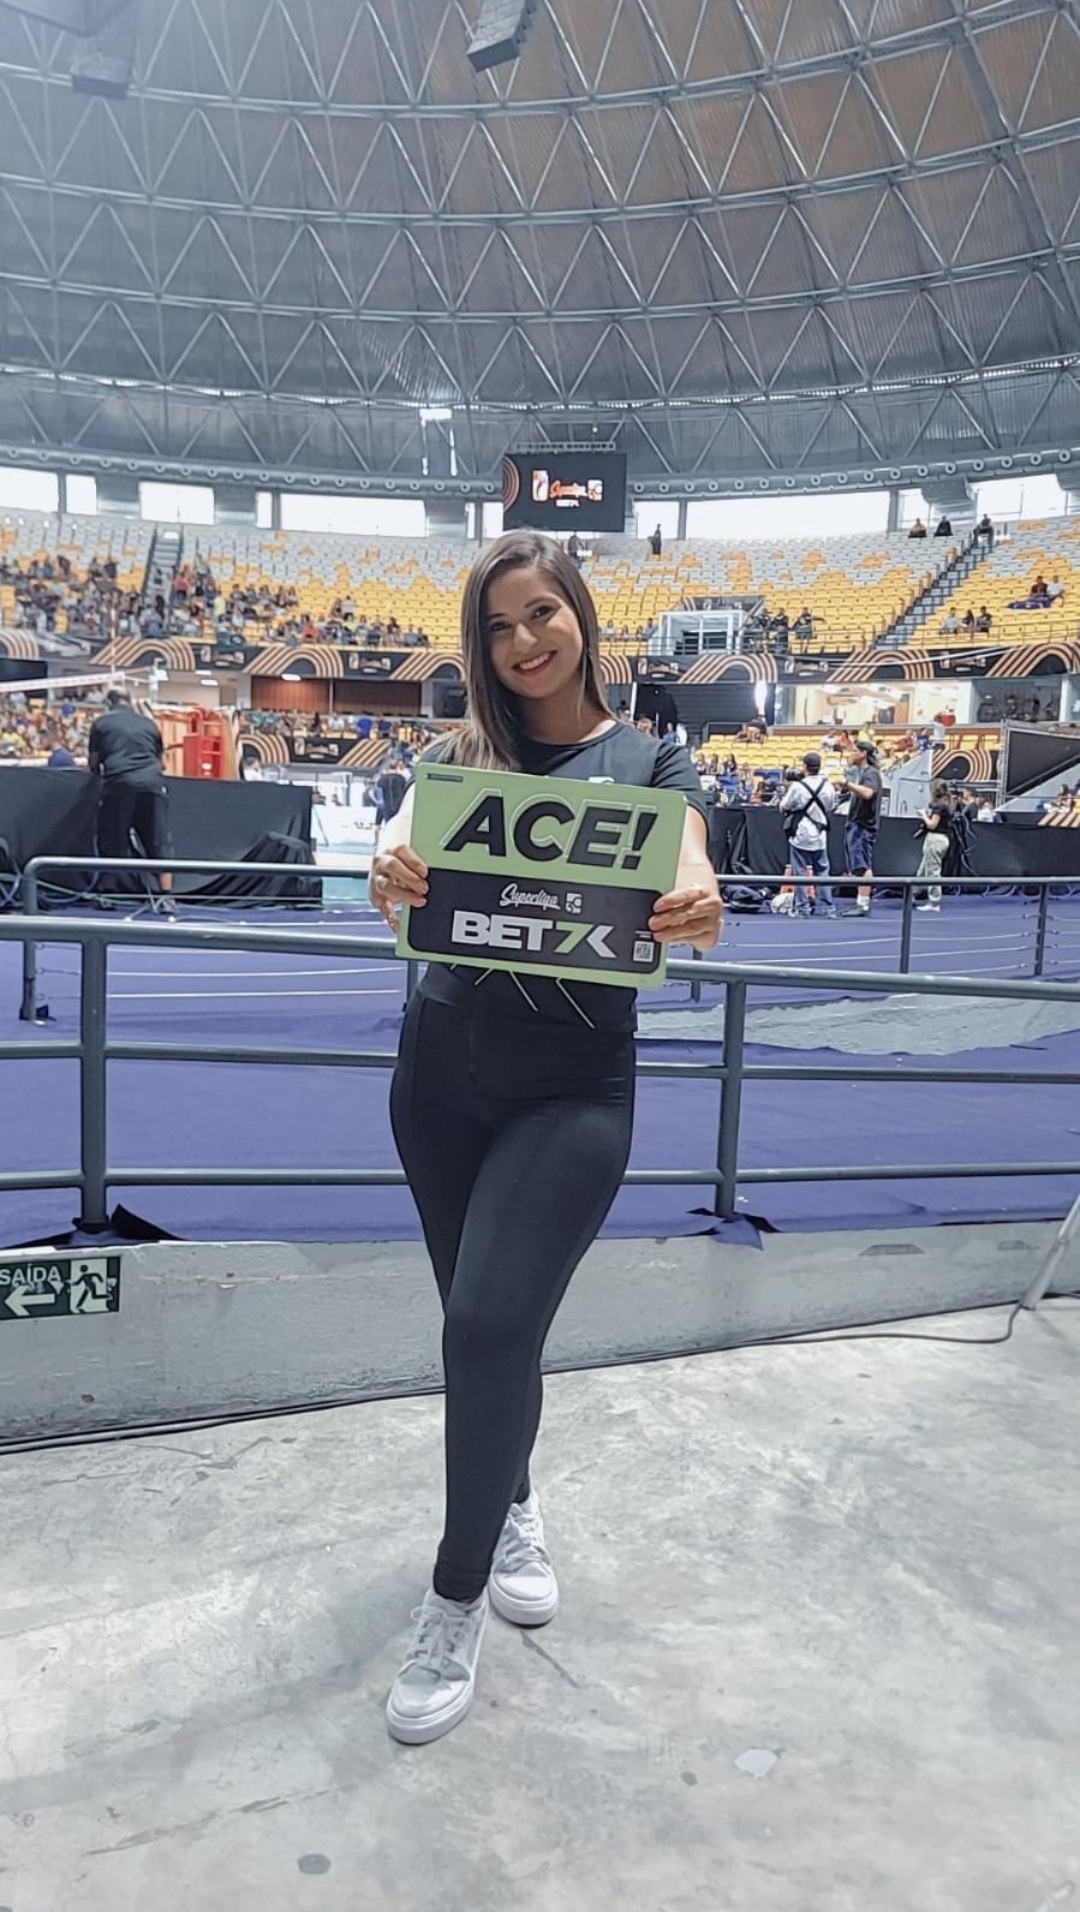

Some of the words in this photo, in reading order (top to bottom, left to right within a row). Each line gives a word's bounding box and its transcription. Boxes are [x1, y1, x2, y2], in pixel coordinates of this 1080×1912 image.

[441, 789, 659, 869] ACE!
[499, 883, 561, 911] Superliga
[451, 909, 617, 959] BET7K
[0, 1263, 62, 1286] SAÍDA
